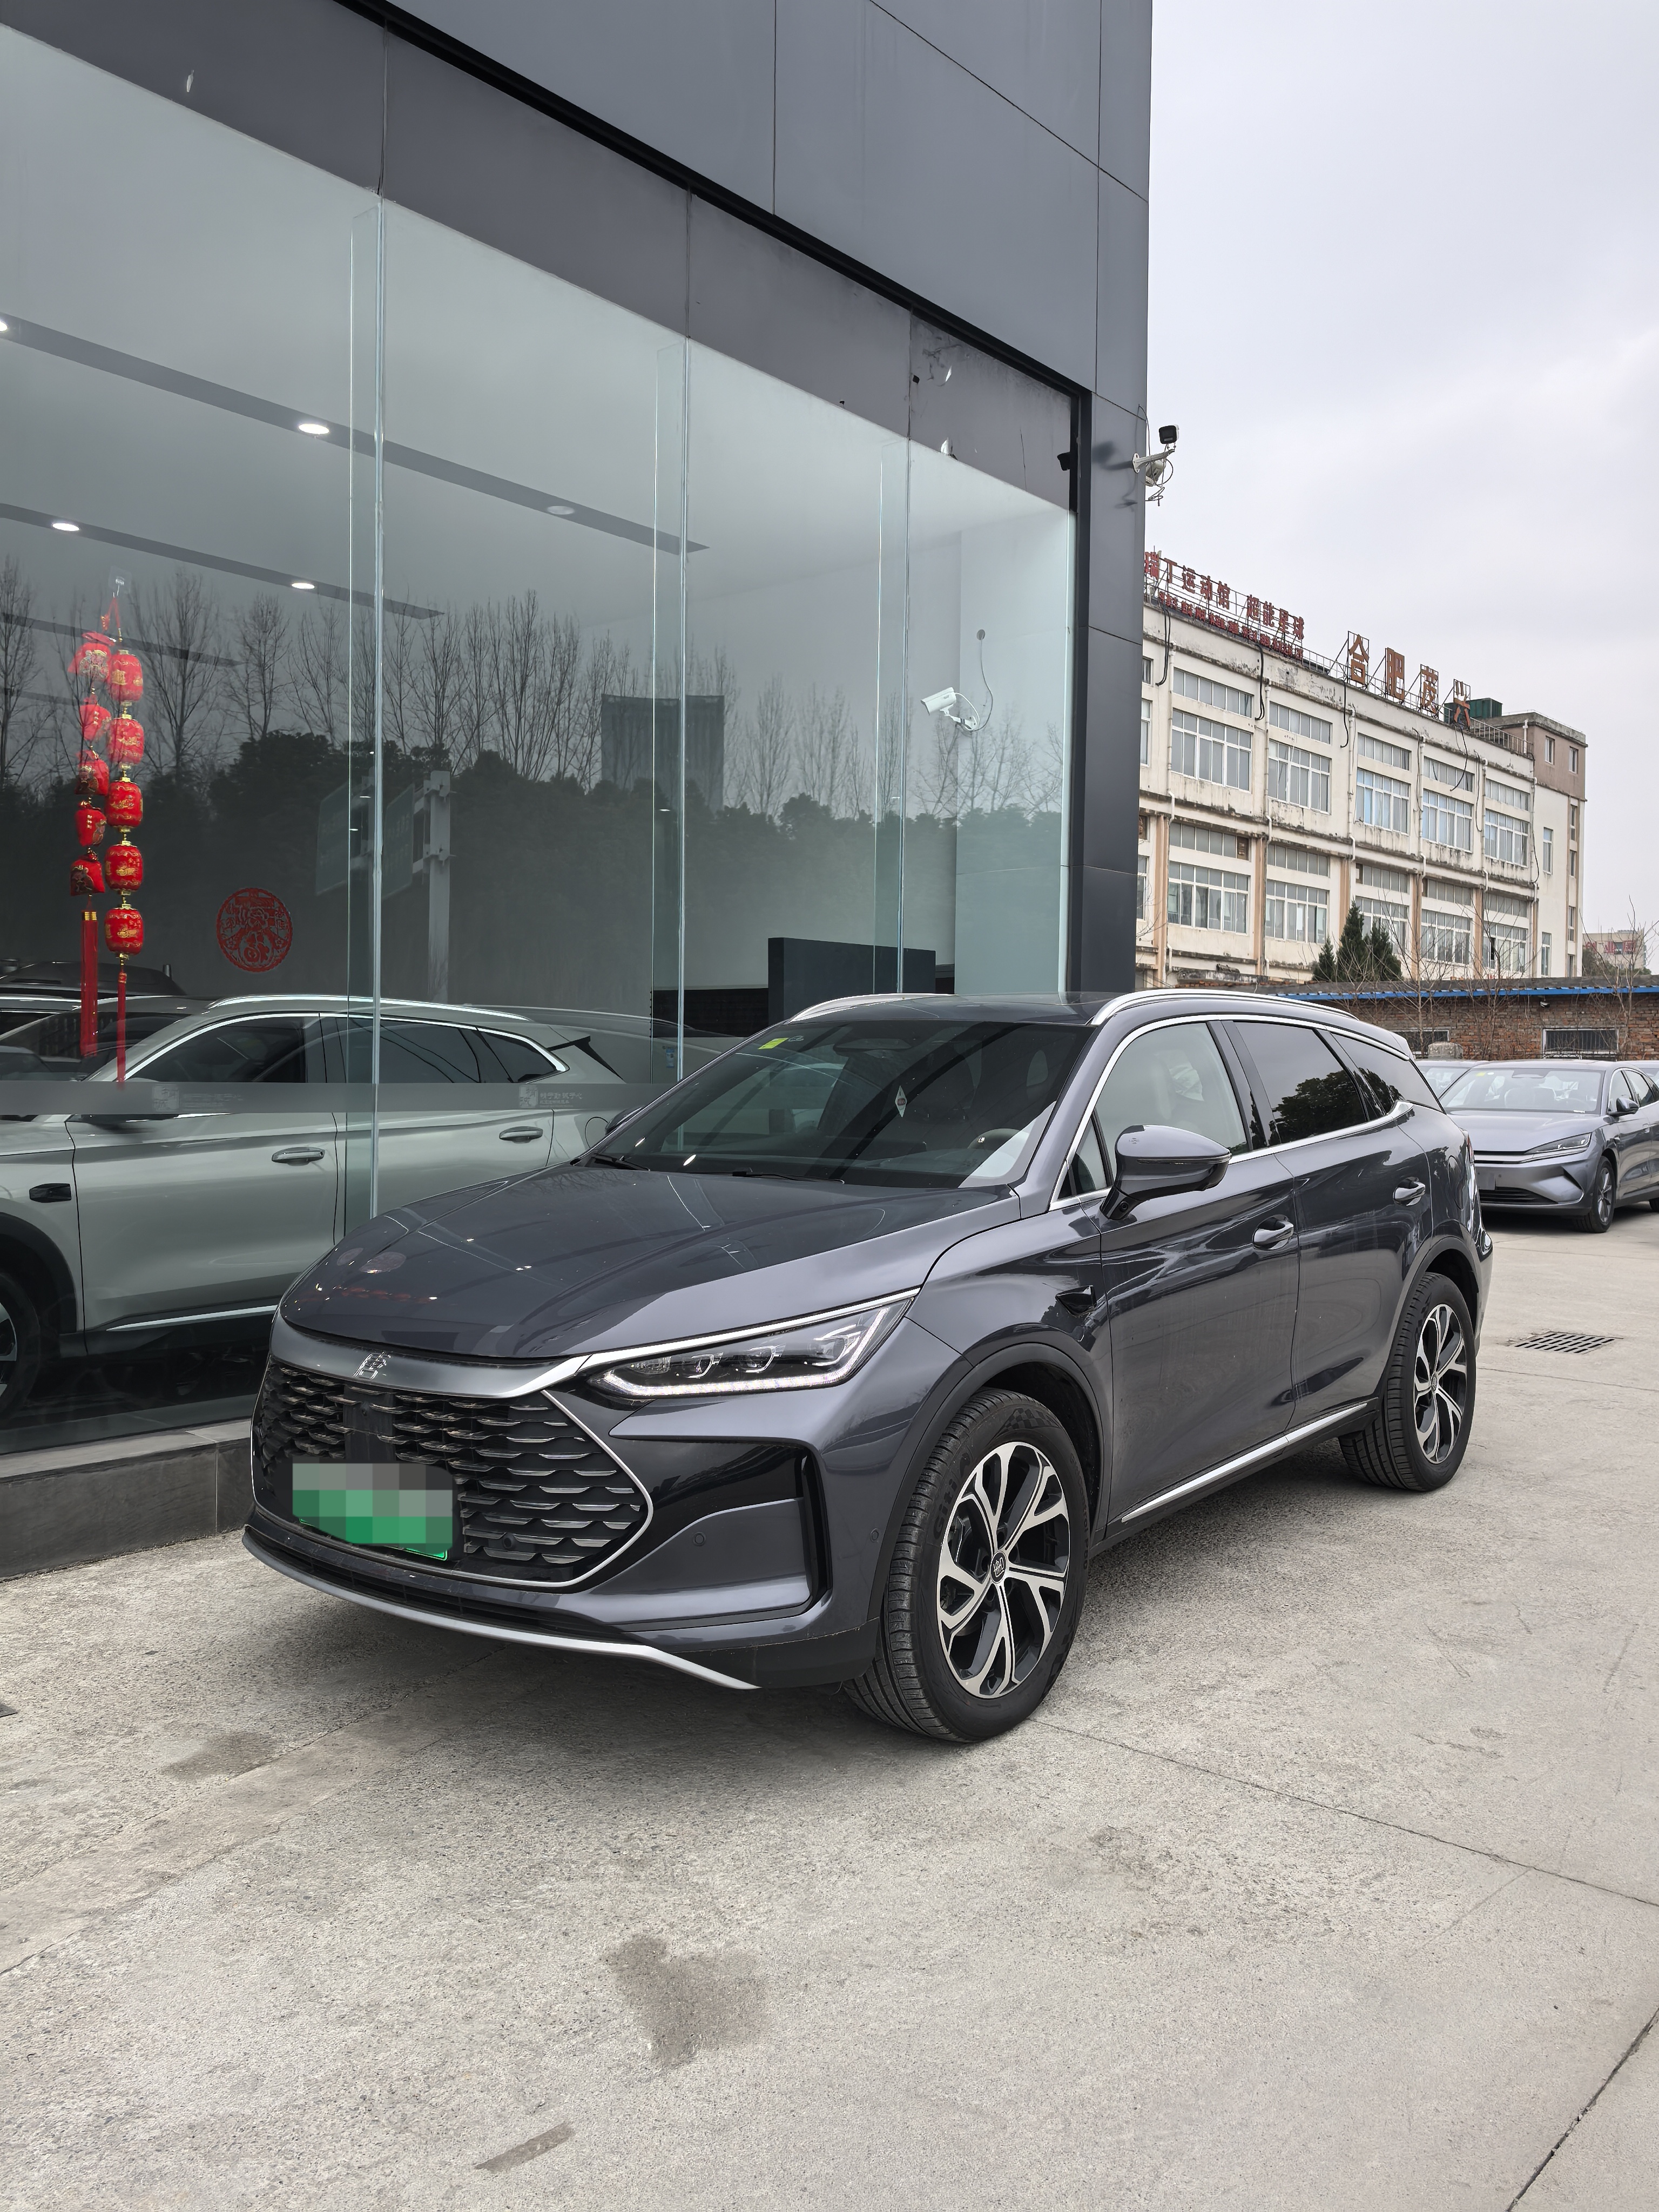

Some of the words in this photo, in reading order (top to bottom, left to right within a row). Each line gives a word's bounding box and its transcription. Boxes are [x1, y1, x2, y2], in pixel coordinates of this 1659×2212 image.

[1246, 594, 1305, 640] 超能星球
[933, 1478, 958, 1539] Giti
